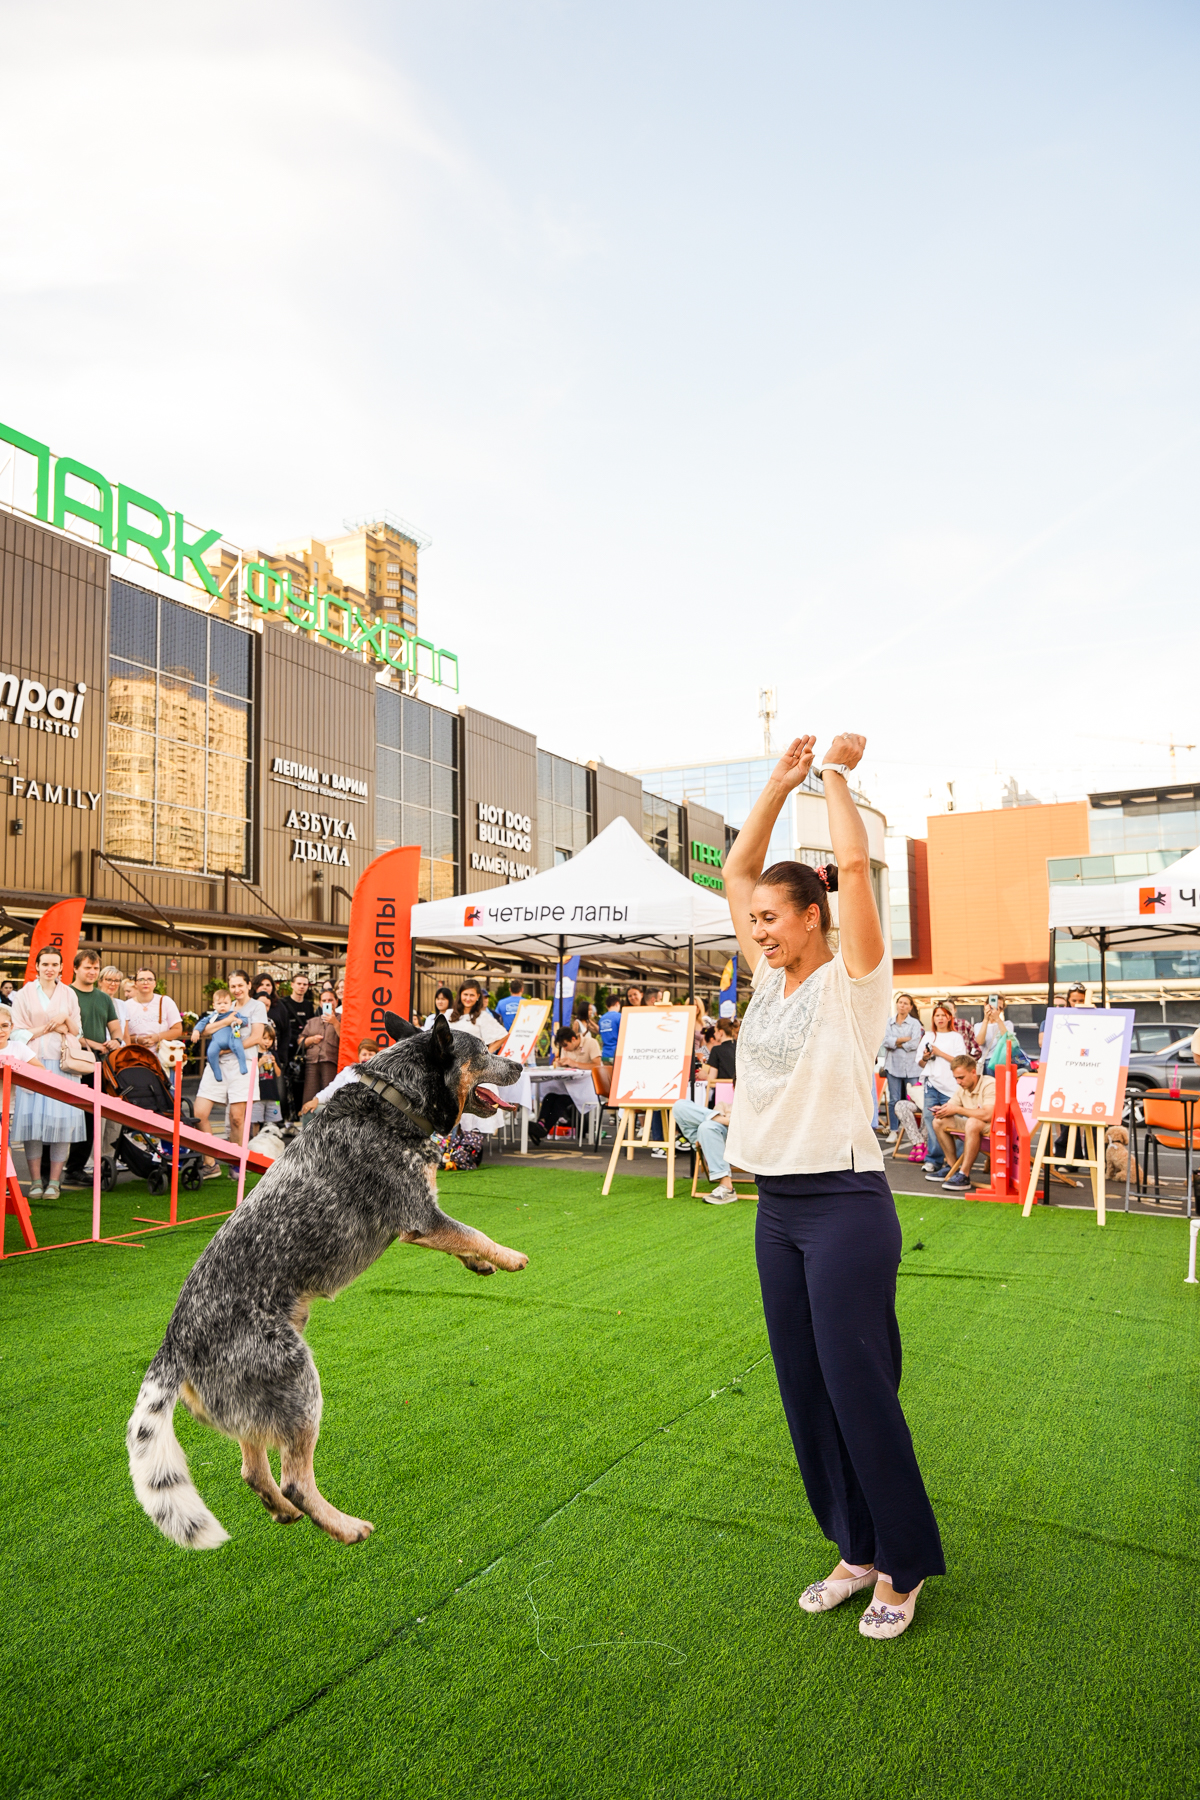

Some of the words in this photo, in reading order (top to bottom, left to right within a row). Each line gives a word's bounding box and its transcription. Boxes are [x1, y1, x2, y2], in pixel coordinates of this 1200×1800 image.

[29, 715, 80, 739] BISTRO
[273, 757, 319, 783] ЛЕПИМ
[332, 773, 368, 797] ВАРИМ
[12, 776, 101, 811] FAMILY
[286, 808, 357, 841] АЗБУКА
[478, 802, 504, 826] HOT
[505, 810, 532, 834] DOG
[292, 838, 351, 867] ДЫМА
[478, 823, 532, 853] BULLDOG
[488, 905, 565, 922] четыре
[570, 905, 628, 922] лапы
[373, 897, 396, 978] лапы
